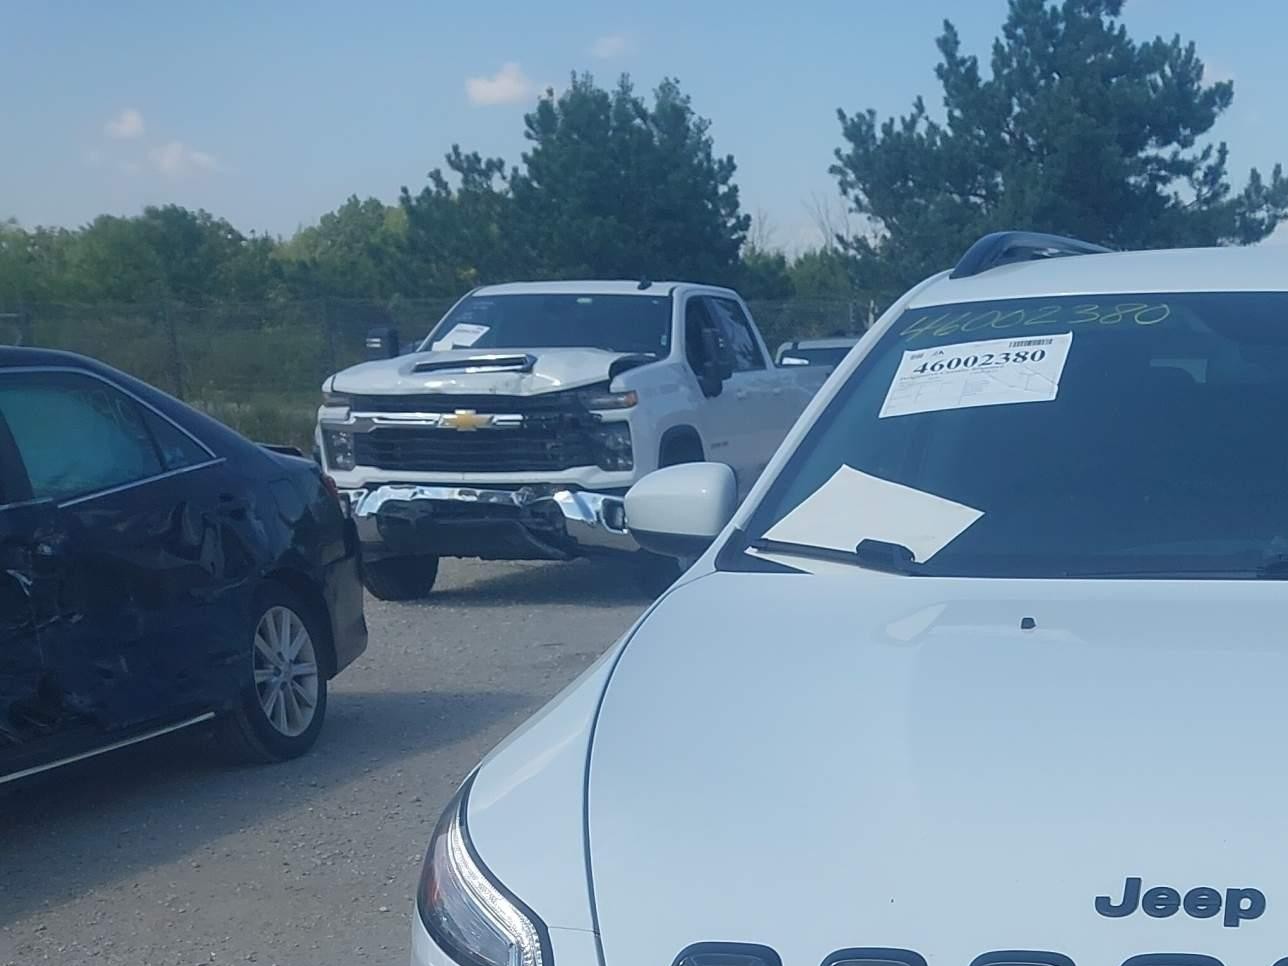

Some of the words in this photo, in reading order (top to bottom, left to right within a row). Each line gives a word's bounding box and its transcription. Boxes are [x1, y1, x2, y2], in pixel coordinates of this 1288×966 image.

[900, 303, 1171, 341] 46002380
[913, 349, 1046, 374] 46002380
[1094, 877, 1266, 928] Jeep
